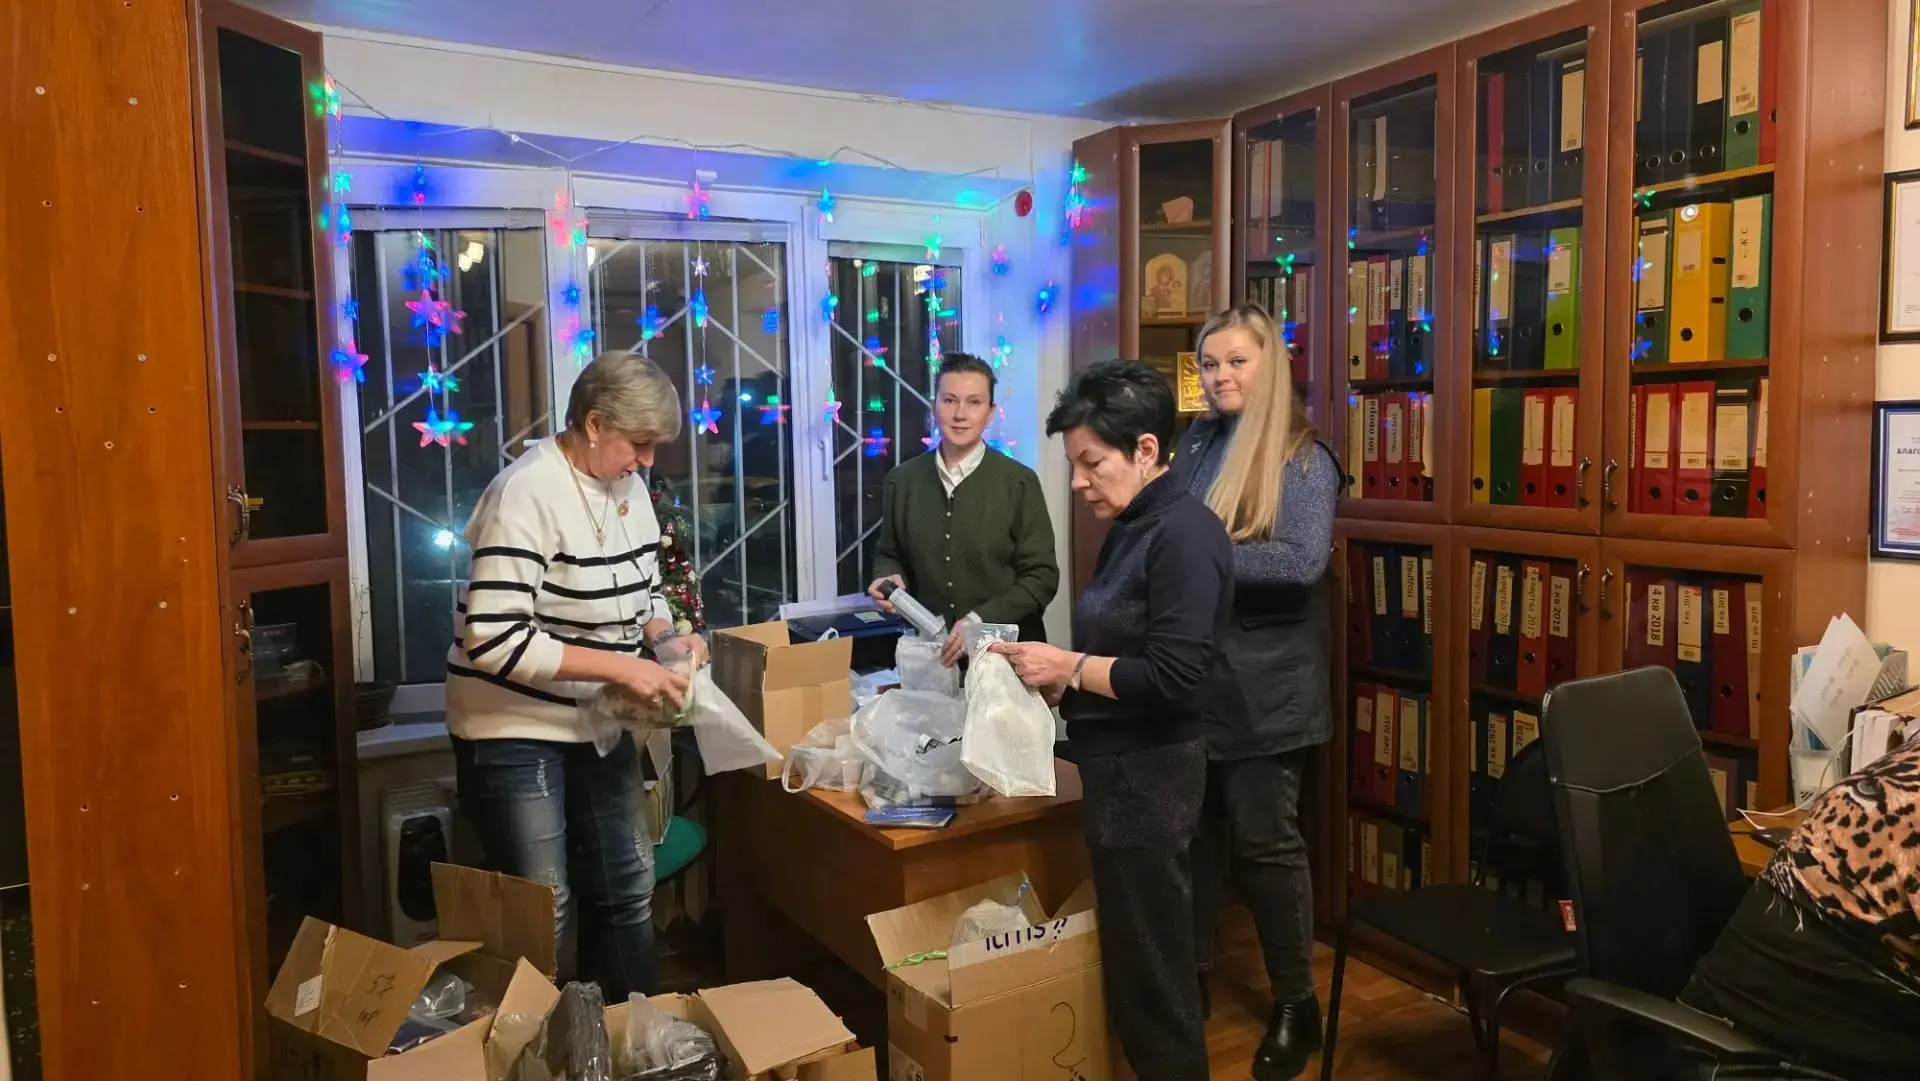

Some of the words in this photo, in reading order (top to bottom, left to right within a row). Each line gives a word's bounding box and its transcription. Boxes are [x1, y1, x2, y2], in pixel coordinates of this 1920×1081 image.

[1651, 588, 1662, 596] 4
[1651, 598, 1660, 612] кв
[1551, 606, 1562, 633] 2018
[1650, 614, 1661, 641] 2018
